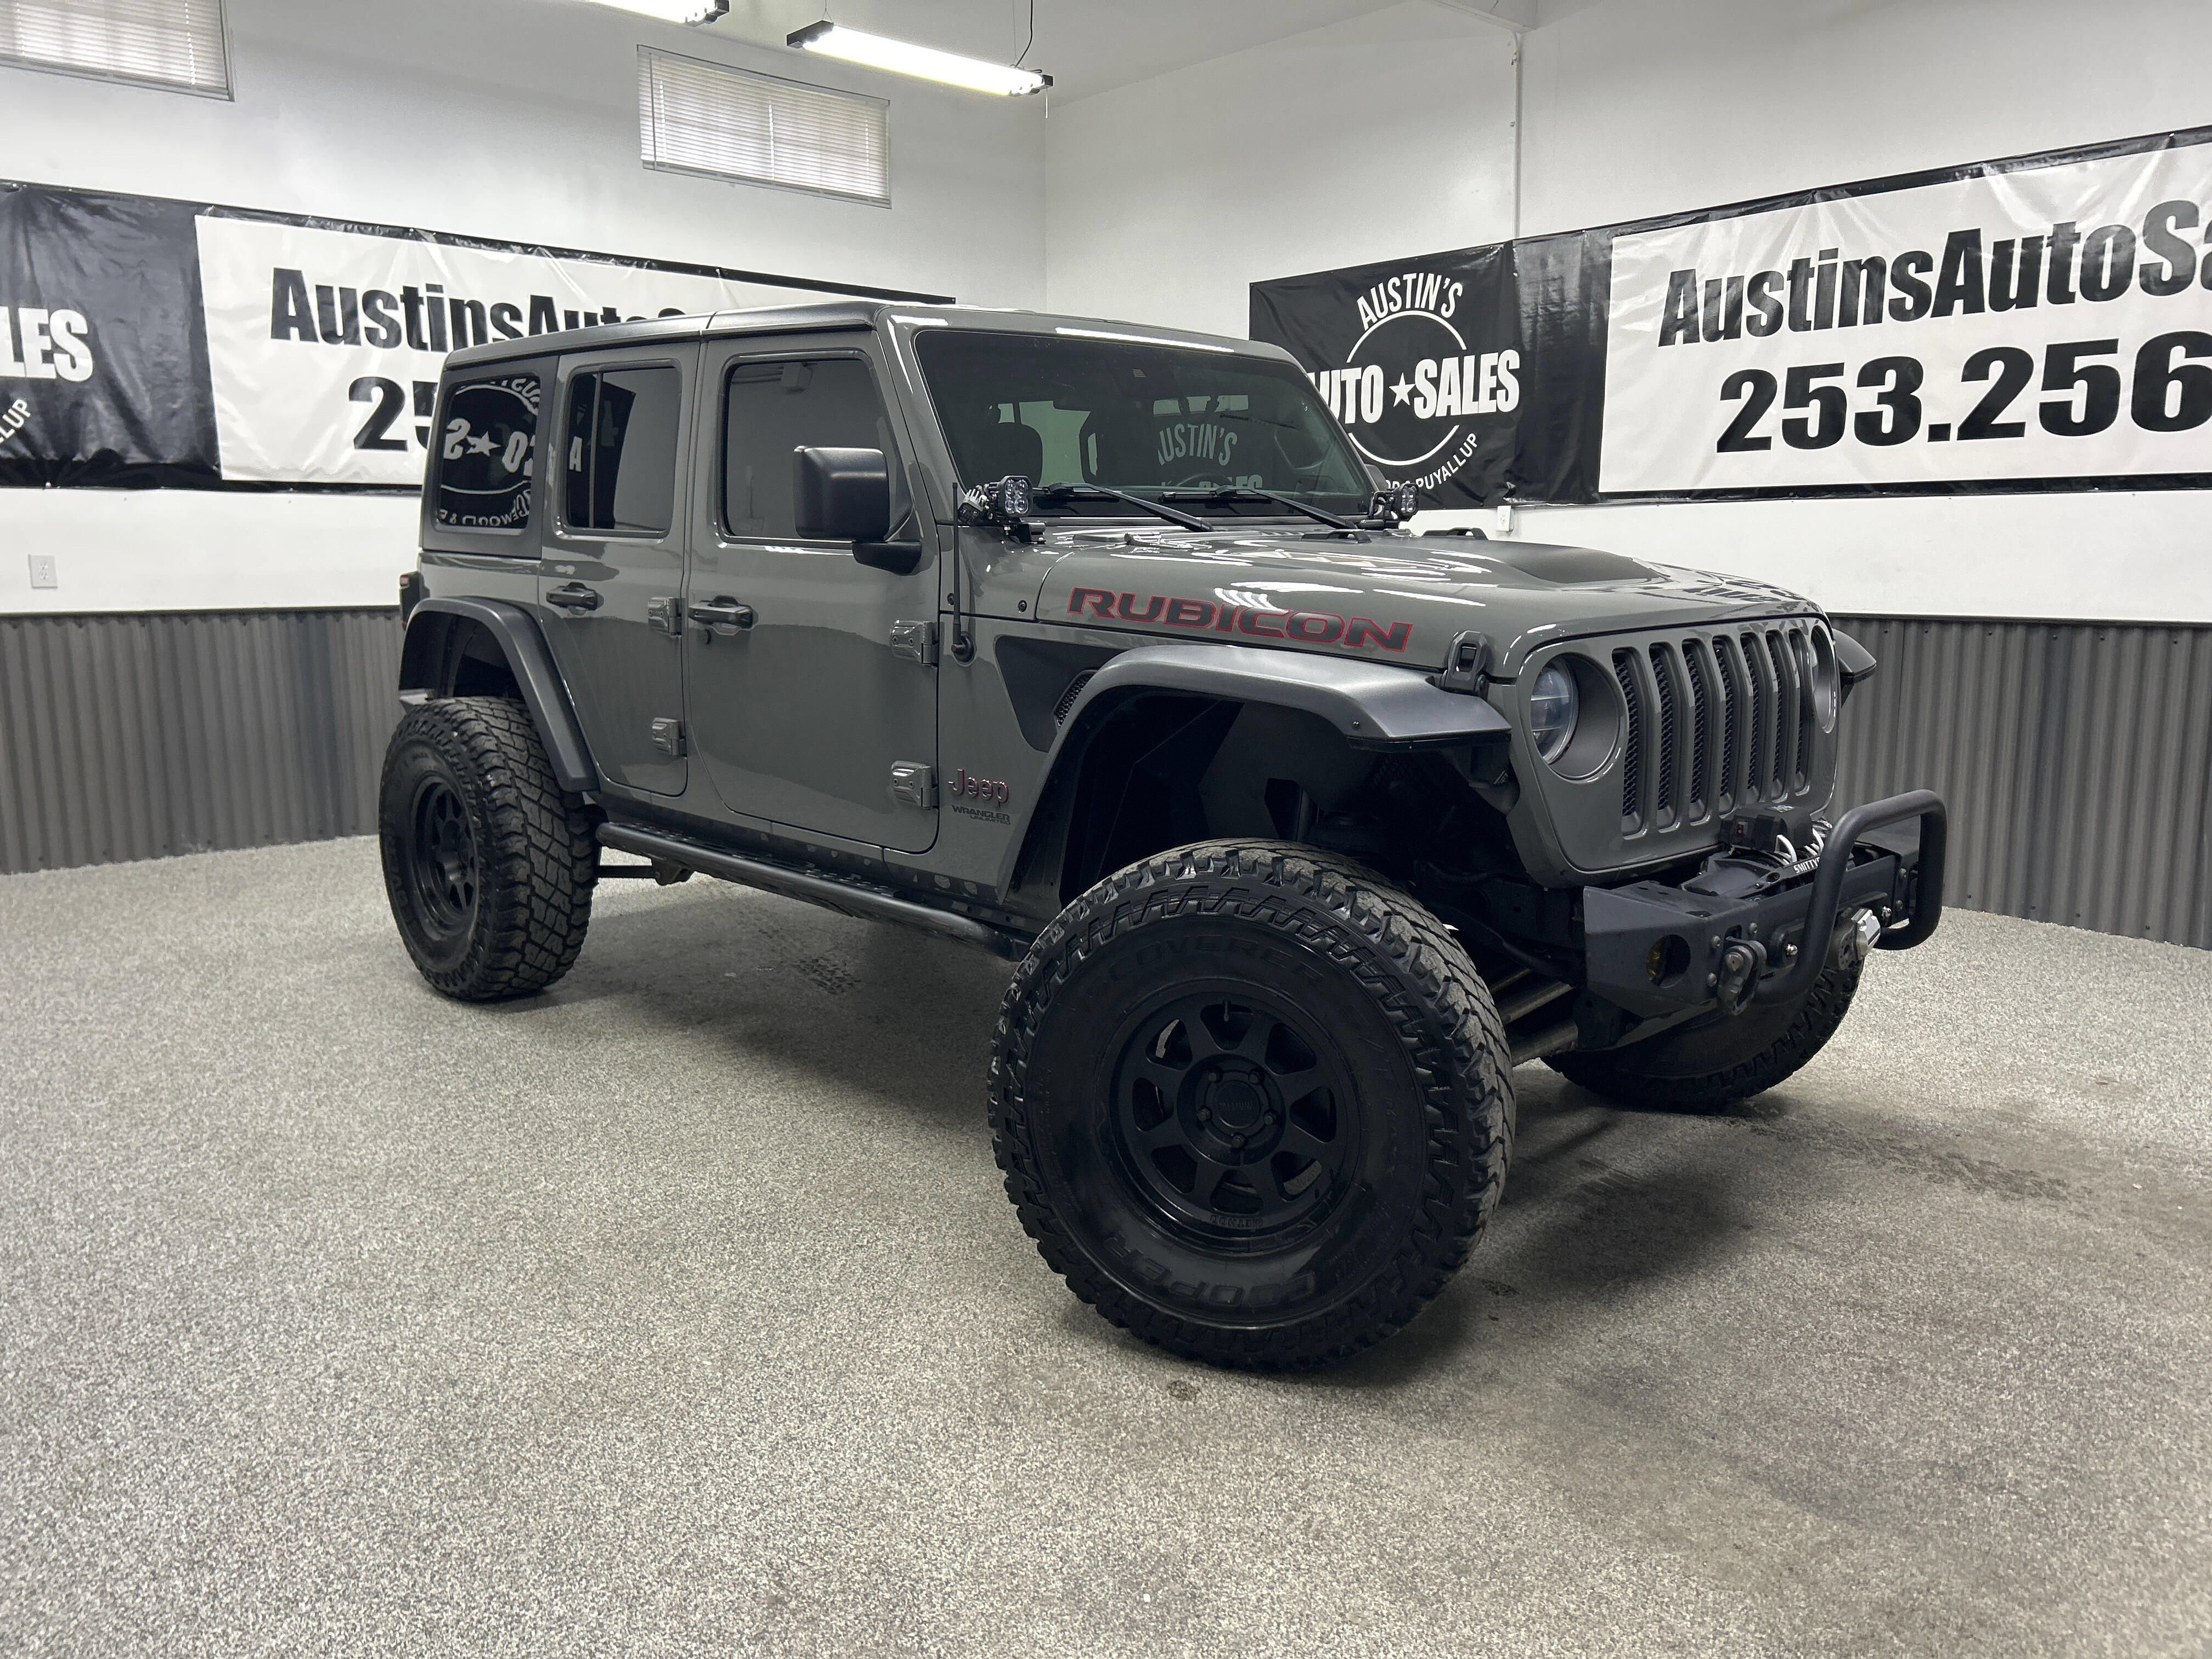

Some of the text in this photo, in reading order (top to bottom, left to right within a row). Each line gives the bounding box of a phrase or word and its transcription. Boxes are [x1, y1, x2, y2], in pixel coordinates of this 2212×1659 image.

[1357, 273, 1463, 330] AUSTIN'S
[1658, 200, 2212, 347] AustinsAutoS
[1307, 349, 1520, 424] UTO SALES
[1717, 331, 2212, 453] 253.256
[0, 399, 31, 443] LUP
[1415, 433, 1477, 489] PUYALLUP
[1067, 587, 1413, 652] RUBICON
[947, 768, 1009, 809] Jeep
[952, 805, 1011, 822] WRANGLER
